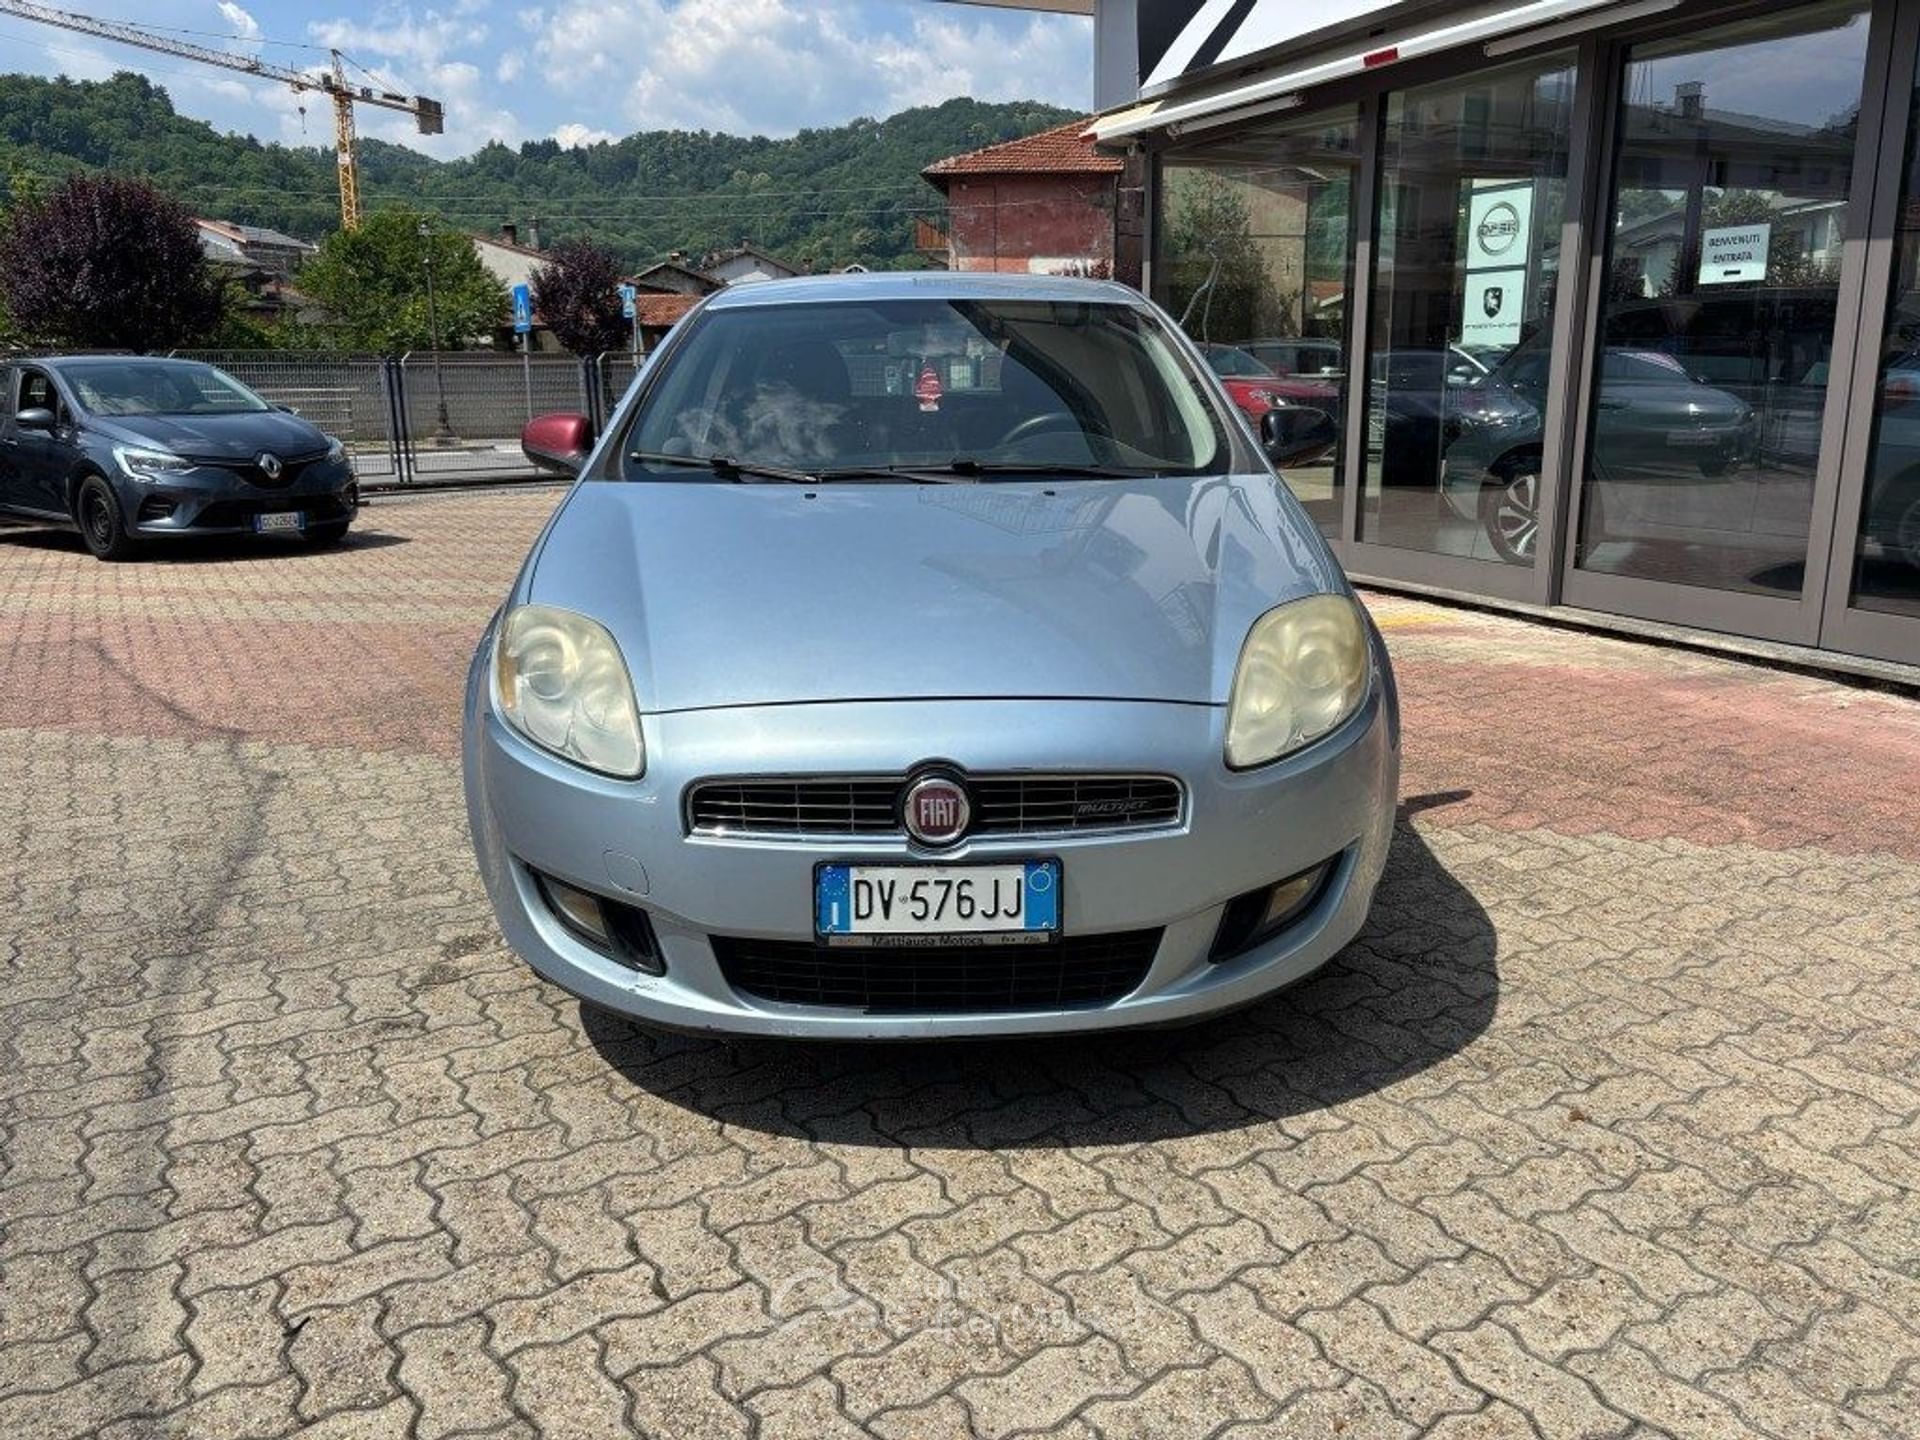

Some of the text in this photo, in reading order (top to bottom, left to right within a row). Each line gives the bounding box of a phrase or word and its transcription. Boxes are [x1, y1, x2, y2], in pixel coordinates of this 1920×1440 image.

[1709, 234, 1760, 247] BENVENUTI
[1712, 251, 1752, 263] ENTRATA
[920, 798, 957, 827] FIAT
[1078, 800, 1149, 814] MULTIJET
[855, 878, 1022, 921] DV 576JJ
